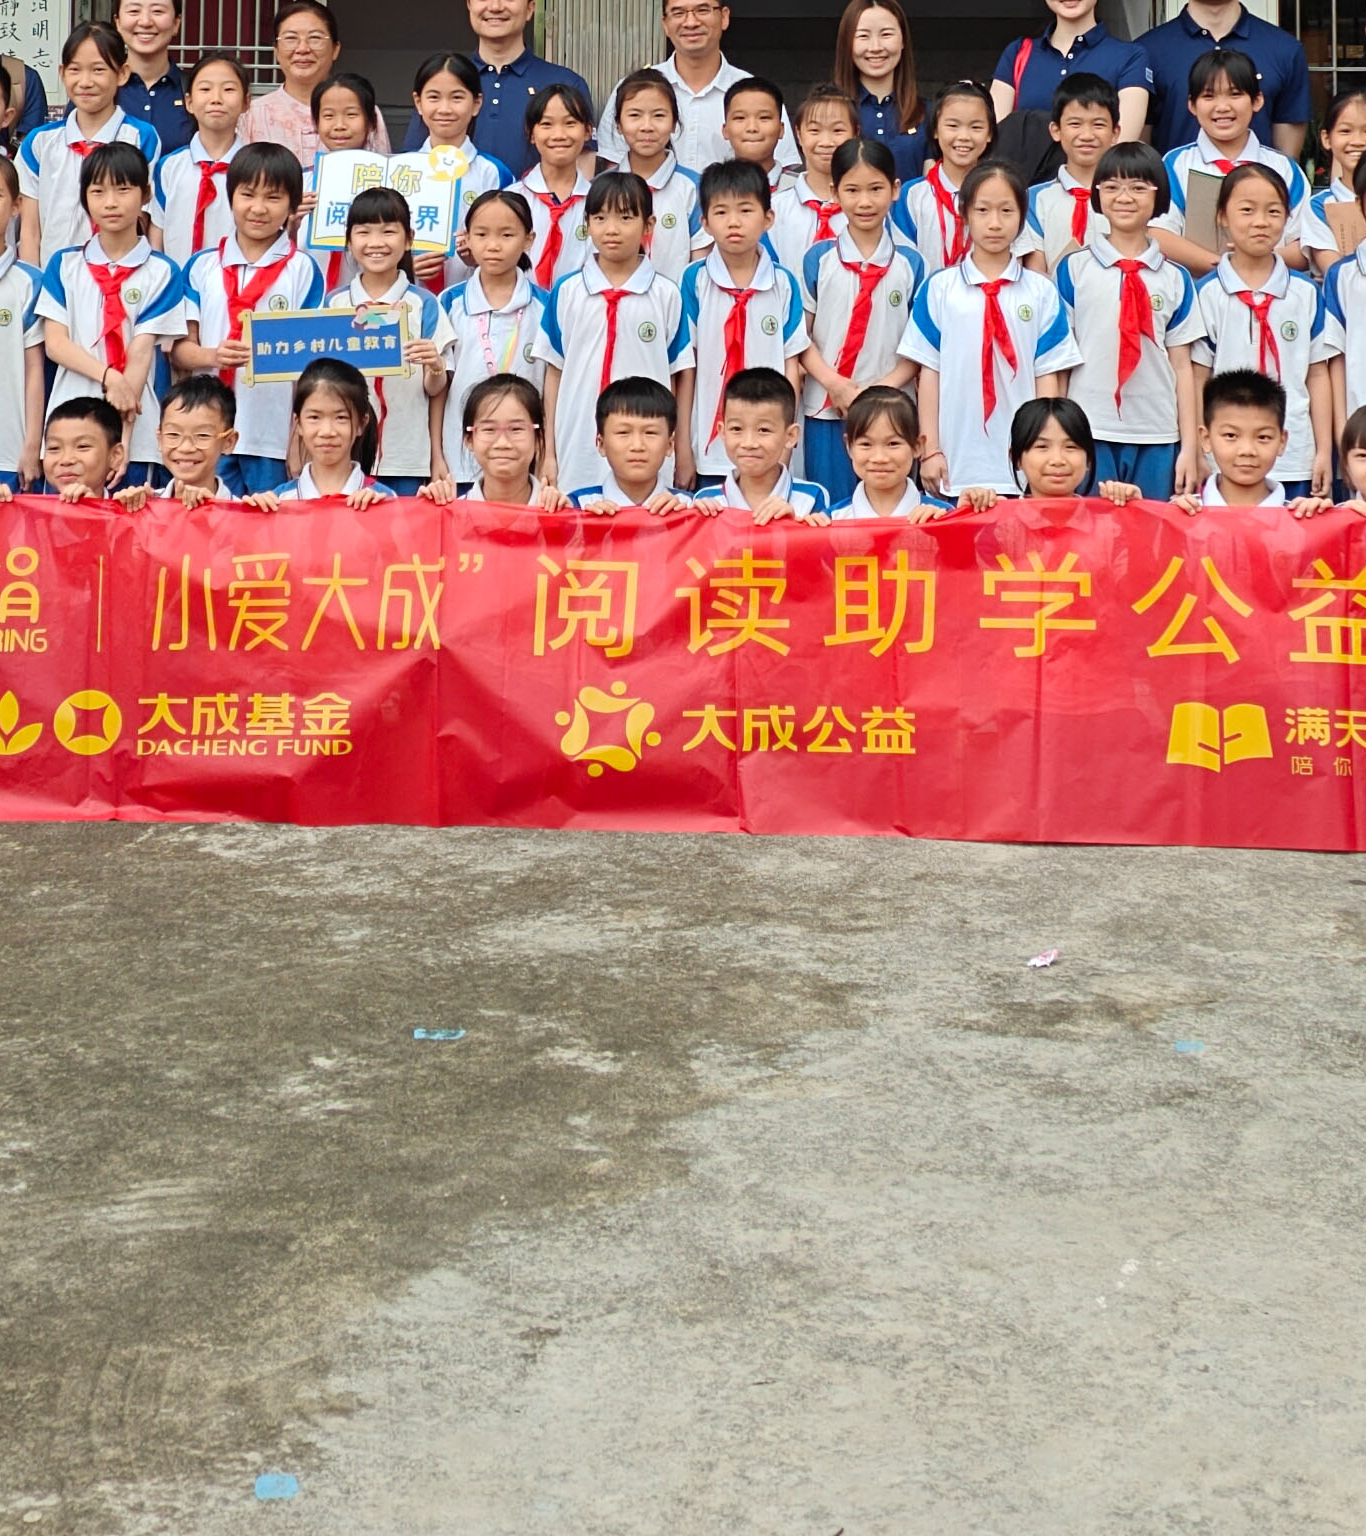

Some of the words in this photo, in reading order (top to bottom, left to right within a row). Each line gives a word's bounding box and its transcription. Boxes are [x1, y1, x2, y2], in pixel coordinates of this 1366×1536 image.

[351, 164, 422, 196] 陪你
[326, 201, 440, 231] 阅界
[257, 335, 397, 356] 助力乡村儿童教育
[153, 552, 484, 651] 小爱大成”
[138, 692, 352, 736] 大成基金
[683, 704, 916, 754] 大成公益
[137, 739, 268, 756] DACHENG
[277, 739, 353, 756] FUND
